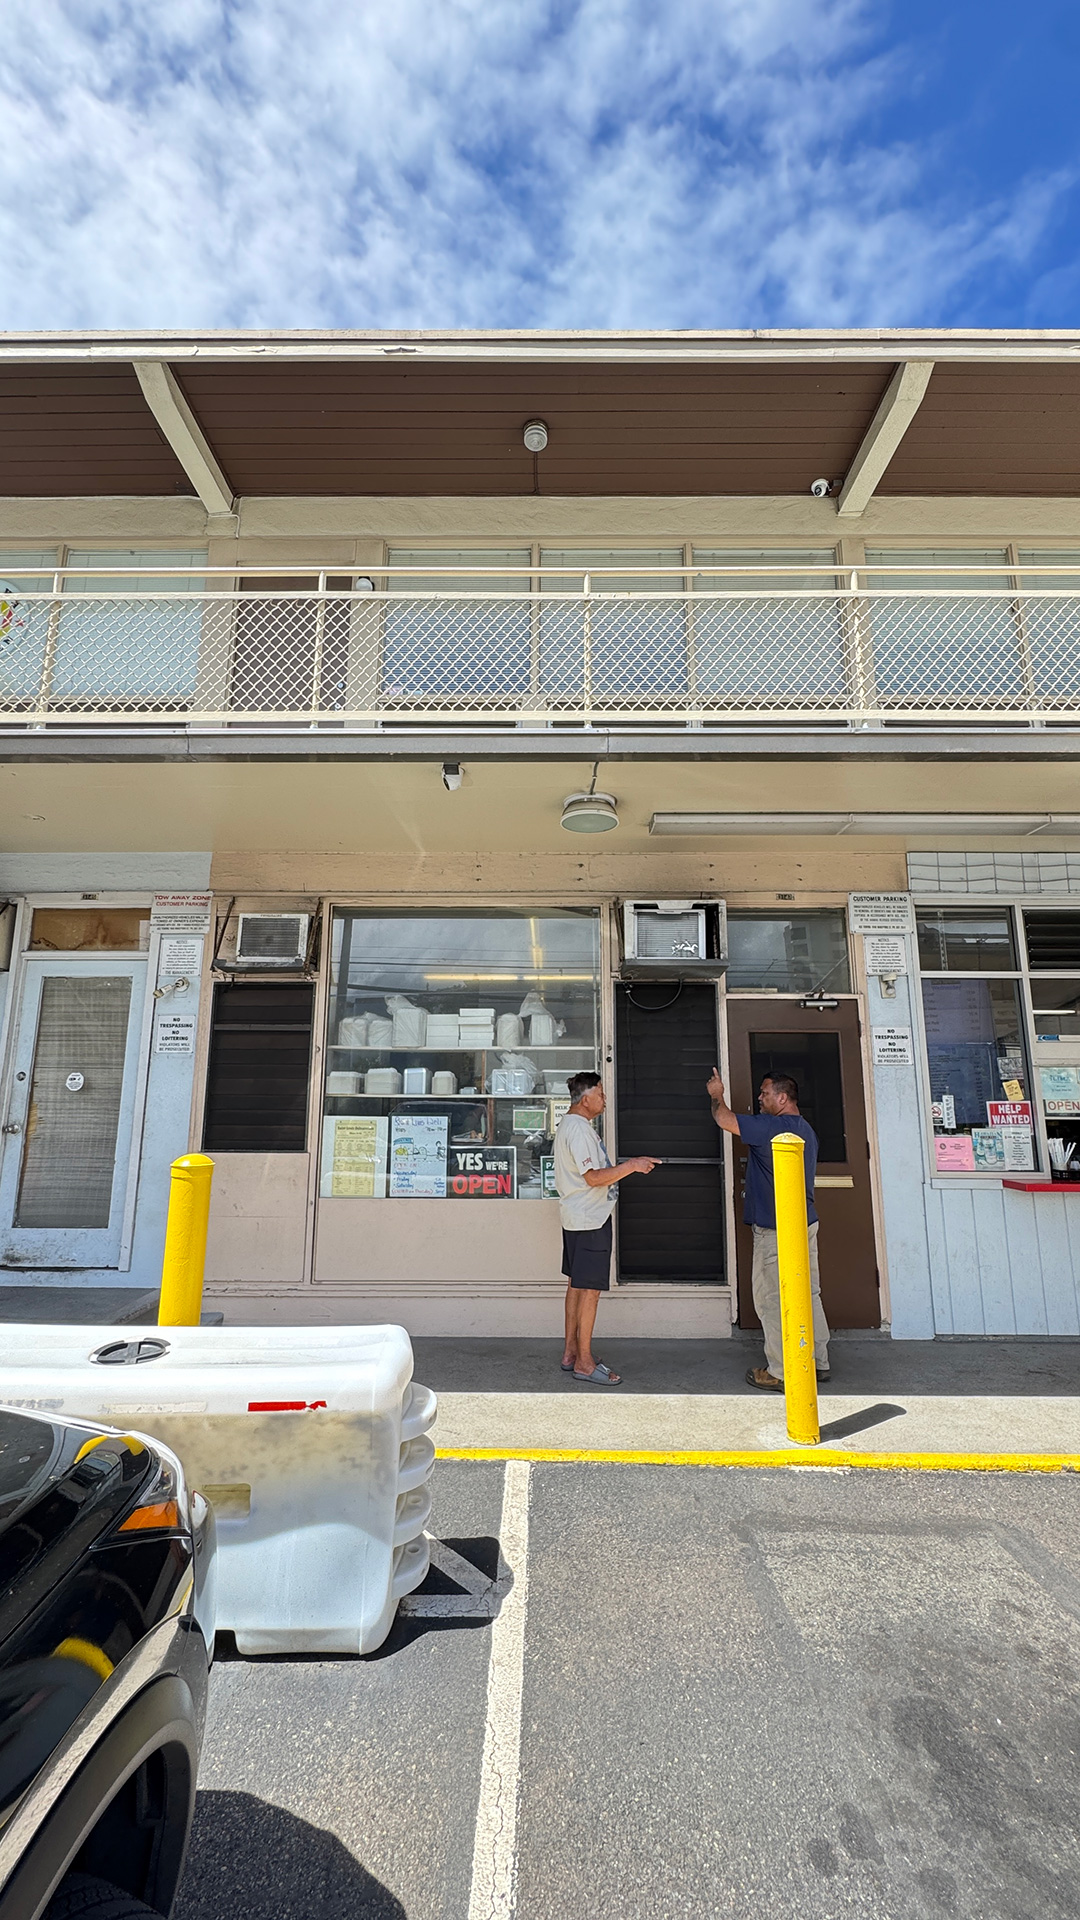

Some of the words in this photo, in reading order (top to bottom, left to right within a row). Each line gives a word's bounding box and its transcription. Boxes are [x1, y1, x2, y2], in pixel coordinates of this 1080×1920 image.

[998, 1104, 1022, 1114] HELP
[1047, 1101, 1080, 1111] OPEN
[992, 1115, 1030, 1124] WANTED
[456, 1153, 484, 1171] YES
[485, 1161, 508, 1171] WE'RE
[452, 1174, 512, 1195] OPEN
